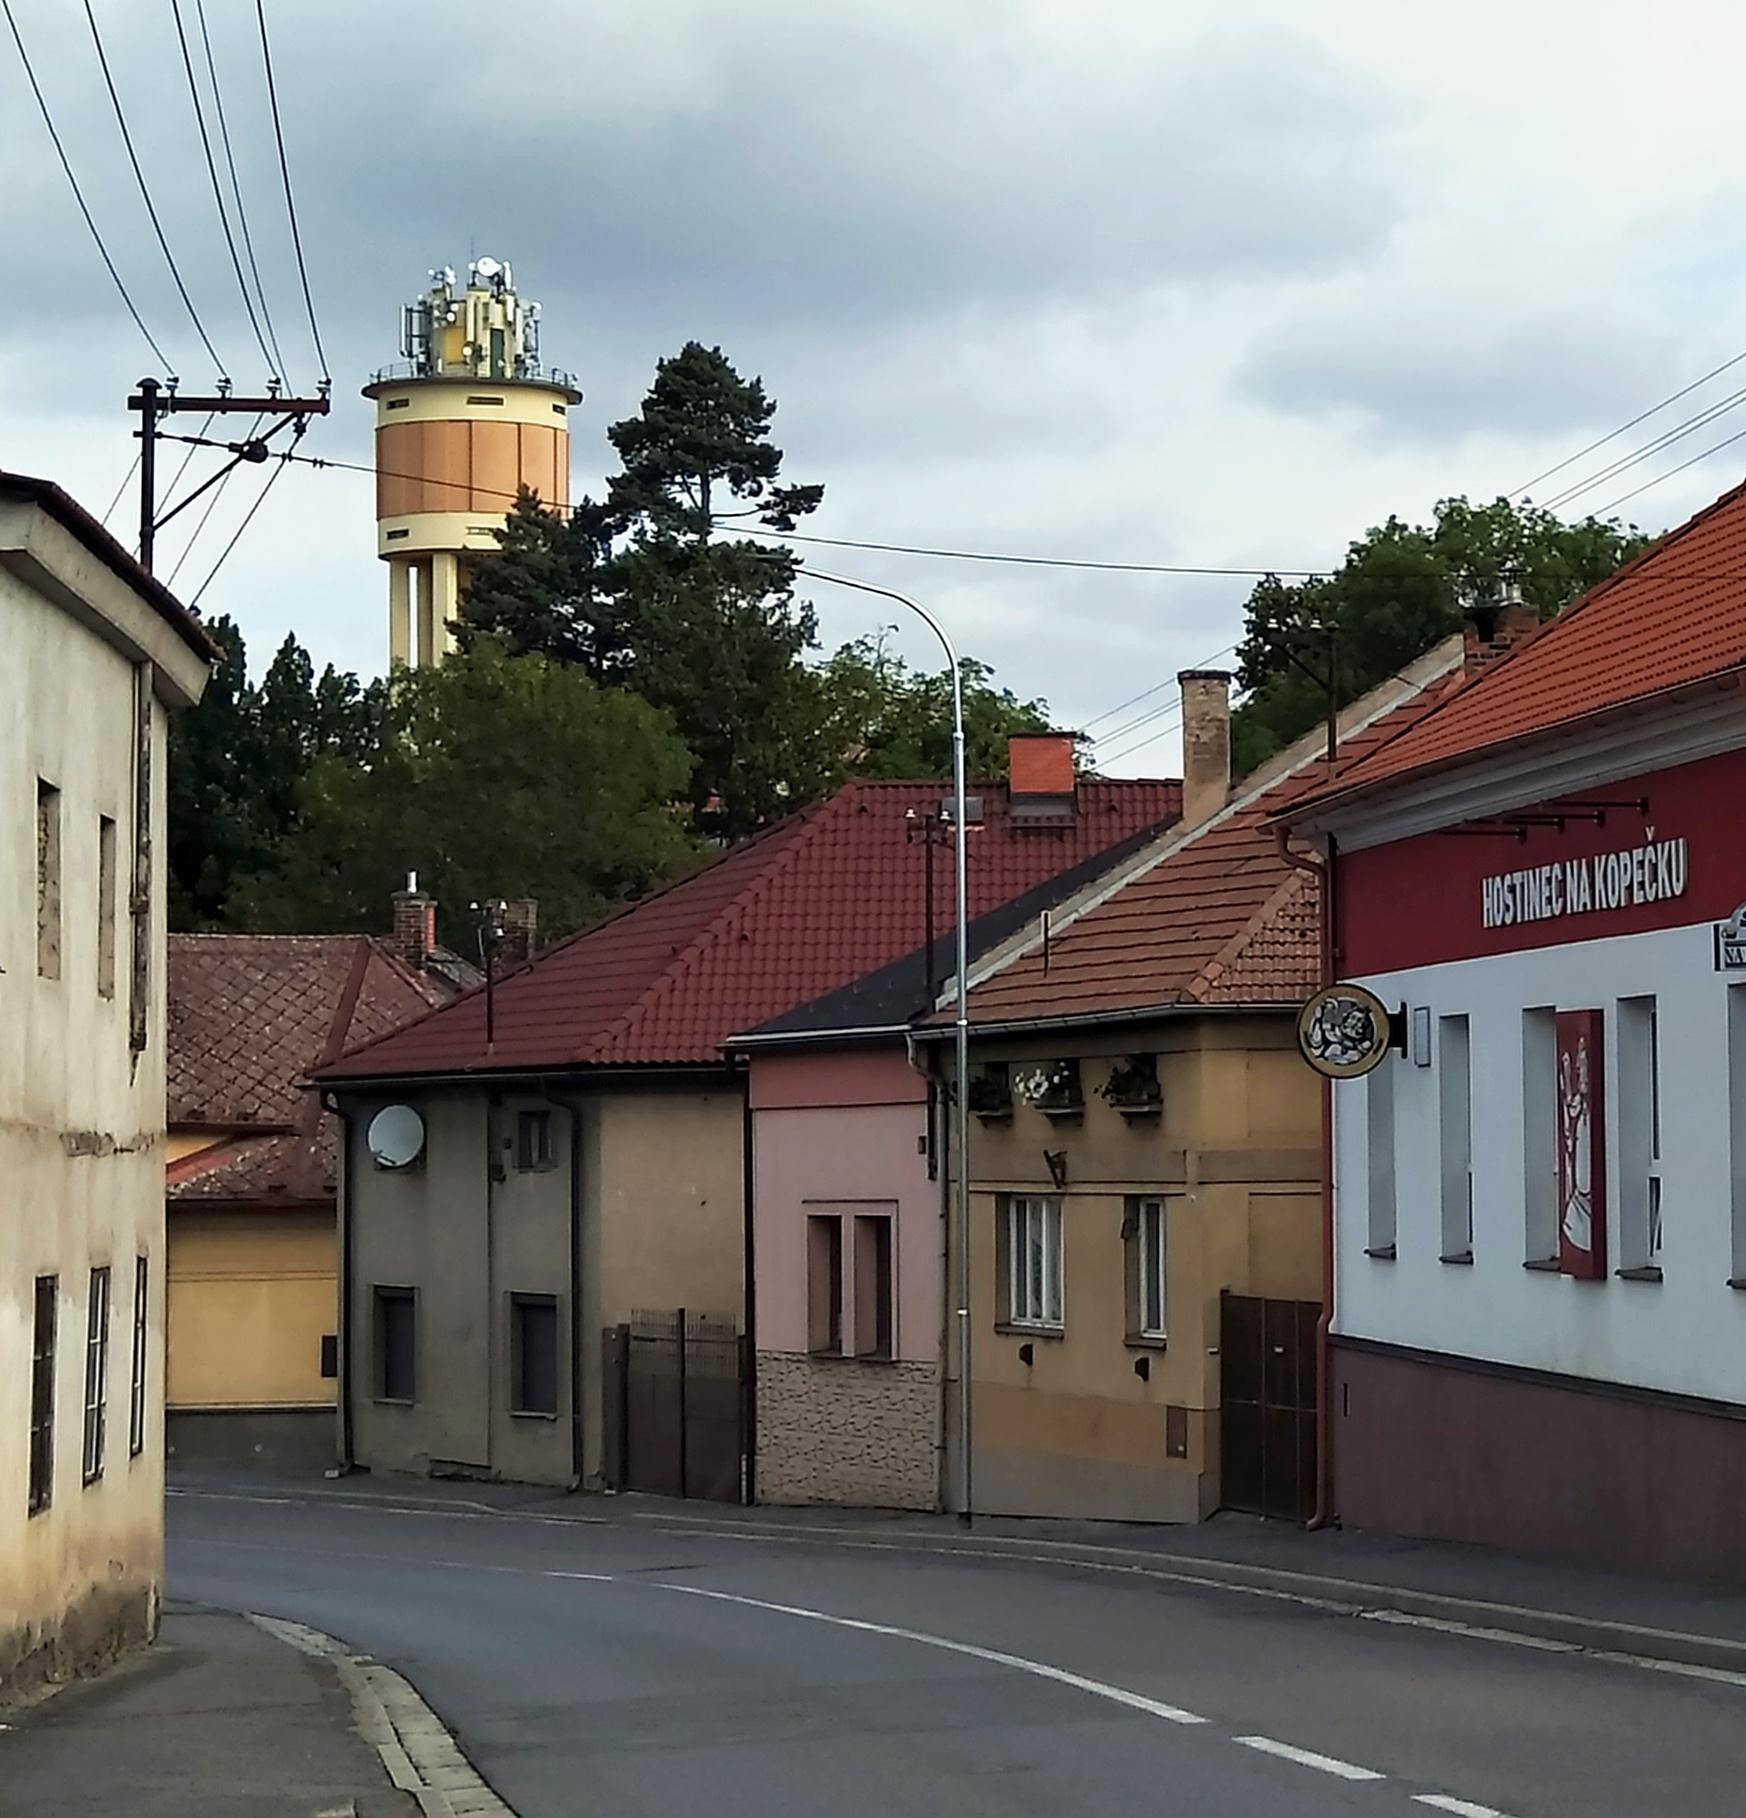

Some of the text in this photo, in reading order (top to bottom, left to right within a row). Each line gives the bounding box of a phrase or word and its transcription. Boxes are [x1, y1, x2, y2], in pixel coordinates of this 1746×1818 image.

[1482, 826, 1688, 928] HOSTINEC NA KOPEČKU
[1725, 946, 1745, 963] NA
